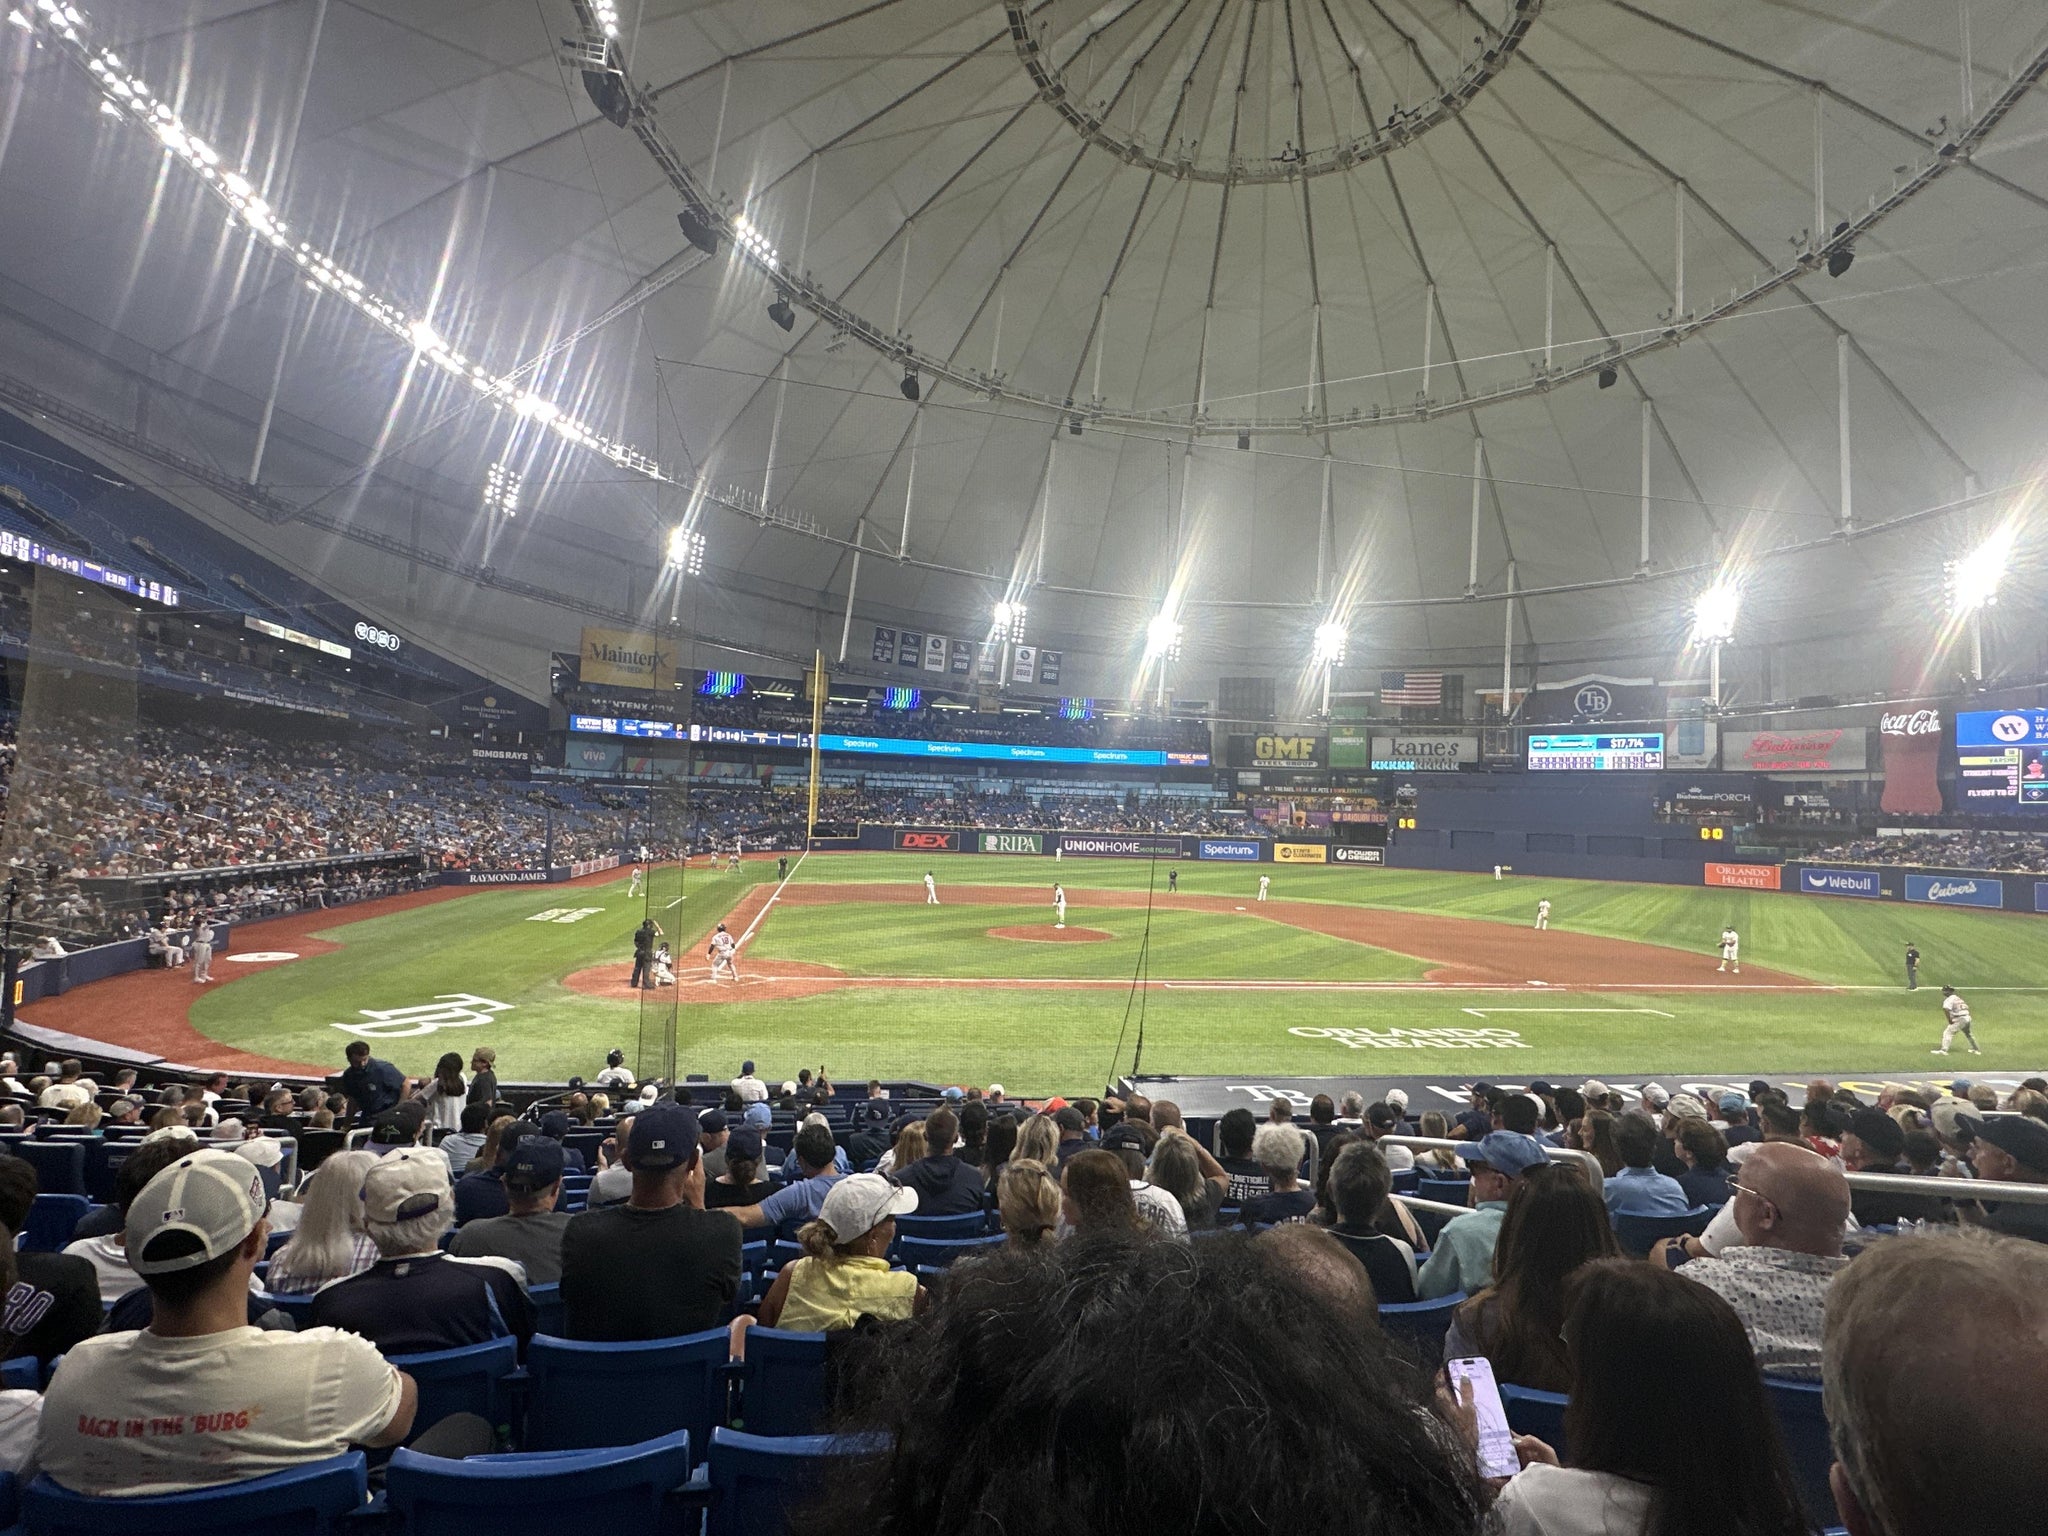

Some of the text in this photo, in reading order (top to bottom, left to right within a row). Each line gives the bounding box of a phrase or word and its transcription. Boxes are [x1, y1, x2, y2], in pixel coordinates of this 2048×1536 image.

[1581, 690, 1606, 711] TB
[1880, 709, 1941, 735] Coca-Cola
[844, 739, 876, 748] Spectrum
[928, 744, 959, 753] Spectrum
[1256, 737, 1315, 759] GMF
[1390, 738, 1460, 756] kane's
[1610, 738, 1645, 749] $17,714
[505, 751, 528, 760] RAYS
[1011, 748, 1043, 757] Spectrum
[1094, 752, 1125, 760] Spectrum
[1714, 793, 1750, 801] PORCH
[902, 833, 950, 848] DEX
[1000, 835, 1037, 852] RIPA
[1204, 844, 1250, 855] Spectrum
[1716, 866, 1770, 877] ORLANDO
[470, 872, 547, 883] RAYMOND JAMES
[1722, 875, 1765, 886] HEALTH
[1829, 876, 1872, 890] Webull
[1928, 881, 1977, 900] Culver's
[1287, 1027, 1521, 1038] ORLANDO
[1331, 1037, 1533, 1049] HEALTH
[78, 1410, 249, 1438] BACK IN THE 'BURG
